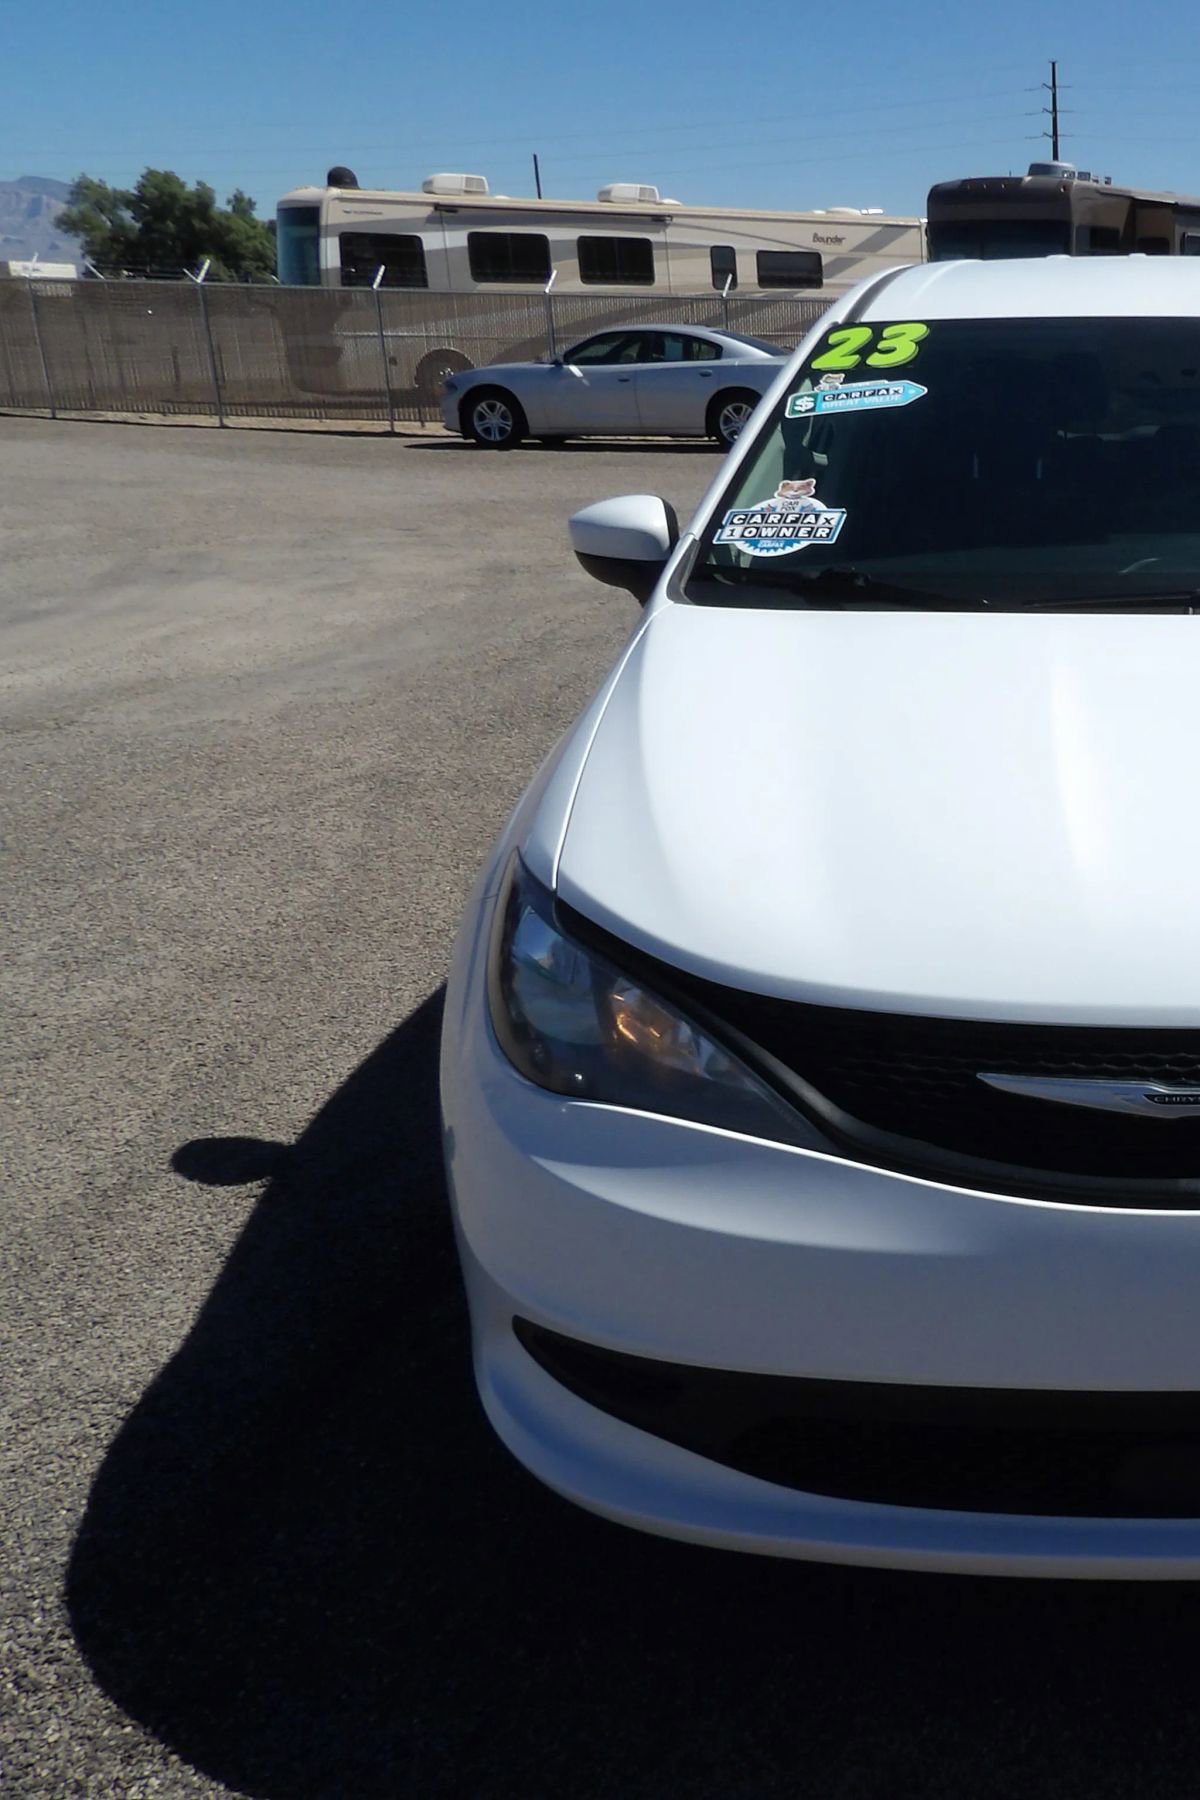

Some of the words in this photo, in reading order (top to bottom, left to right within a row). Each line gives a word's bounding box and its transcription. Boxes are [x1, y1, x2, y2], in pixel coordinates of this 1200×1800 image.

[811, 323, 929, 370] 23
[824, 386, 904, 401] CARFAX
[732, 513, 835, 526] CARFAX
[743, 526, 831, 538] OWNER
